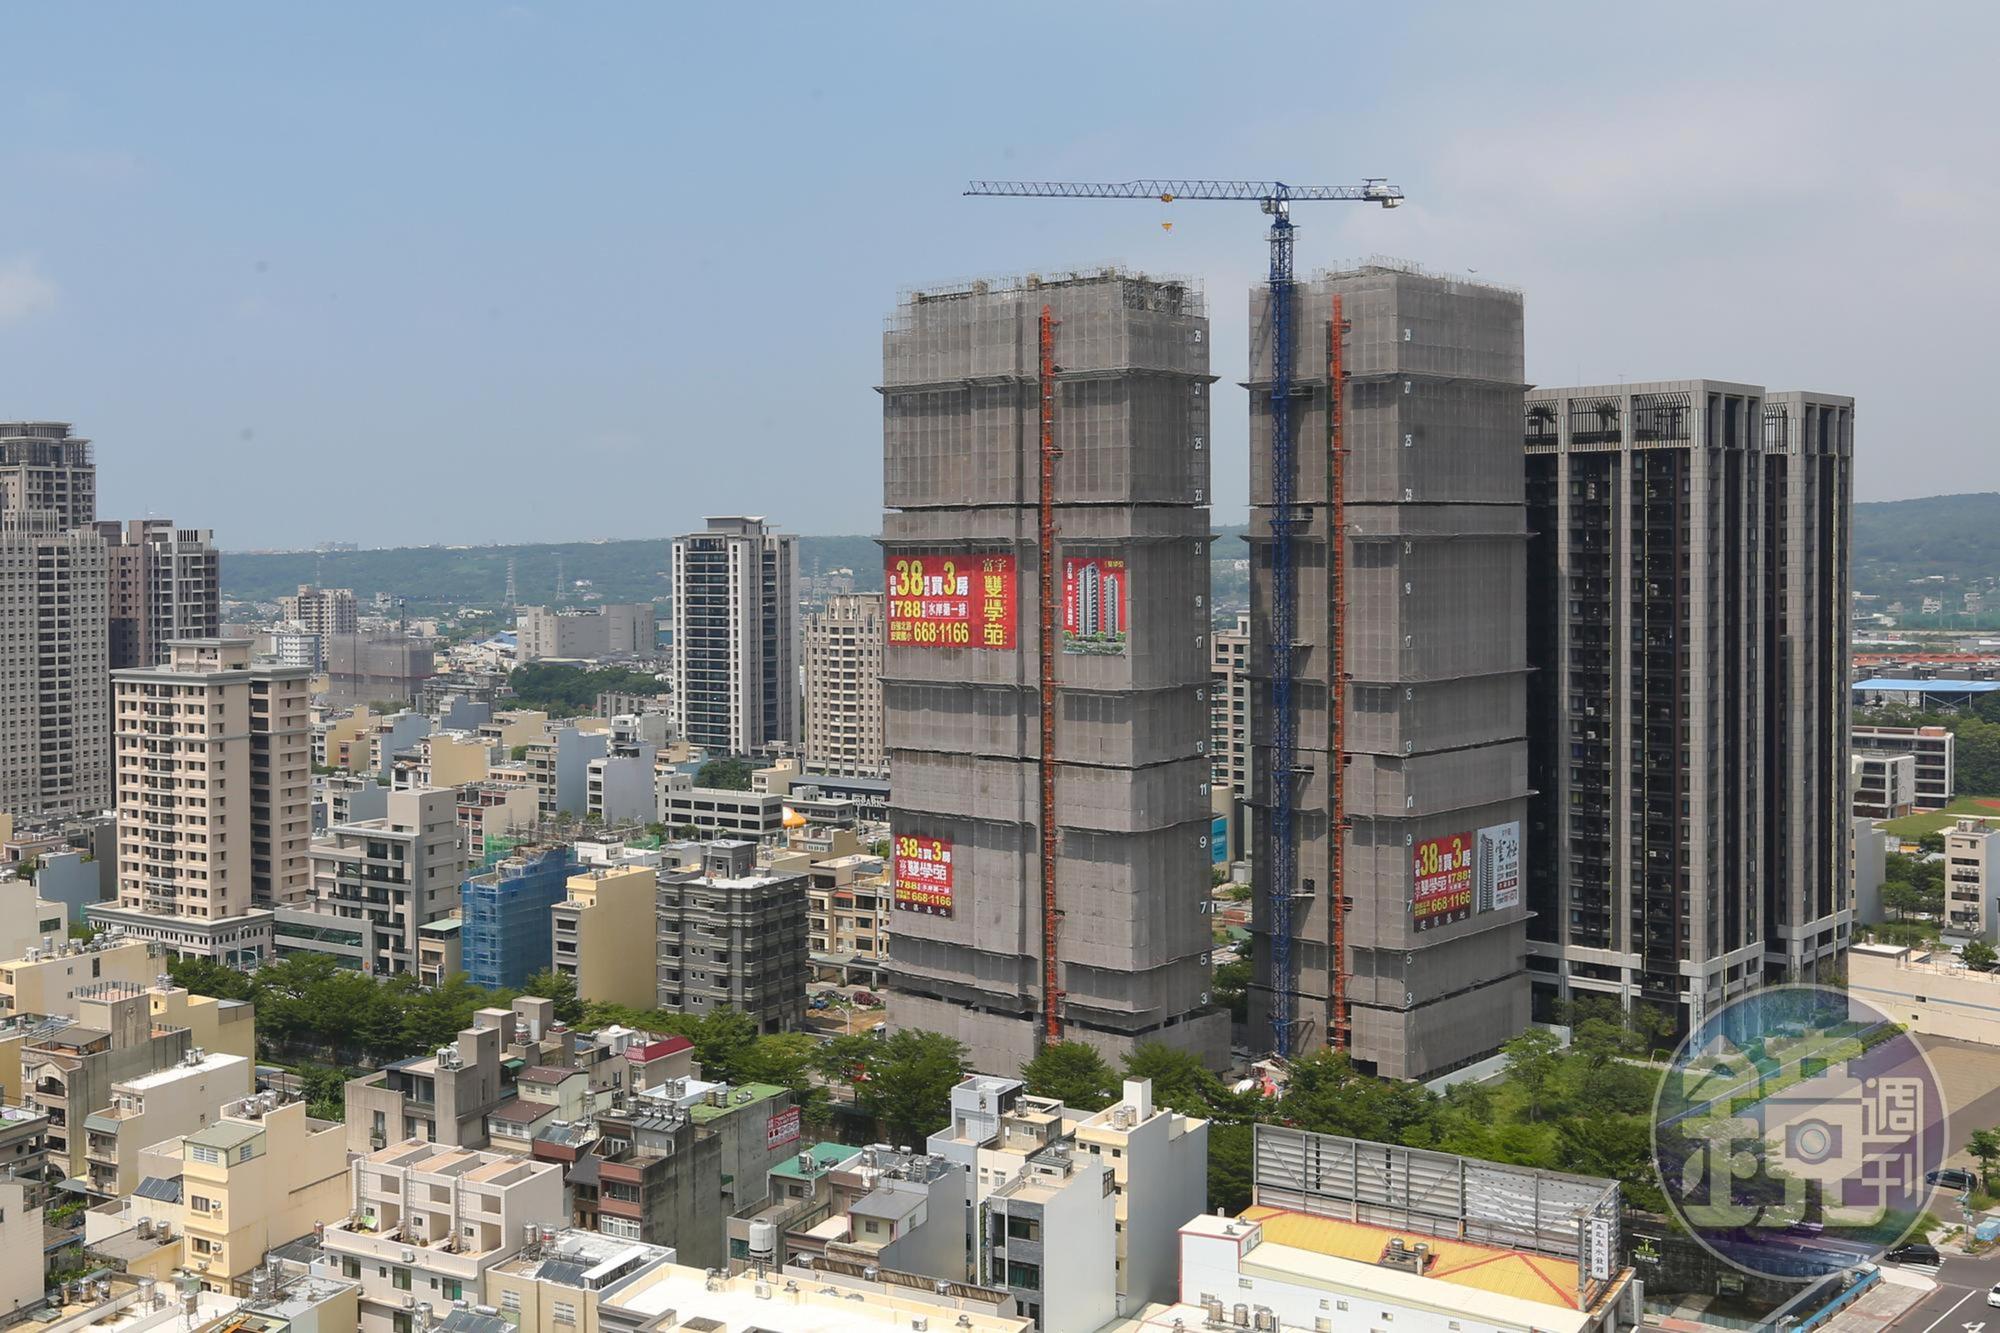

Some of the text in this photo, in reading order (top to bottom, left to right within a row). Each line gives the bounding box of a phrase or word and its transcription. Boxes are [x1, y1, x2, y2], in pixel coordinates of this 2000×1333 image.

[1194, 330, 1202, 342] 29
[1194, 382, 1201, 394] 27
[1404, 381, 1411, 394] 27
[1194, 438, 1202, 450] 25
[1405, 434, 1412, 446] 25
[1195, 490, 1202, 501] 23
[1406, 488, 1412, 501] 23
[1195, 542, 1202, 554] 21
[1405, 542, 1411, 554] 21
[983, 558, 1006, 572] 富宇
[1195, 596, 1201, 607] 19
[1196, 636, 1202, 648] 17
[1196, 740, 1203, 753] 13
[1200, 784, 1207, 796] 11
[1200, 836, 1207, 848] 9
[1406, 834, 1412, 846] 9
[1200, 901, 1207, 914] 7
[1407, 899, 1413, 912] 7
[1200, 954, 1207, 965] 5
[1406, 952, 1412, 964] 5
[1200, 992, 1207, 1004] 3
[1406, 992, 1412, 1004] 3
